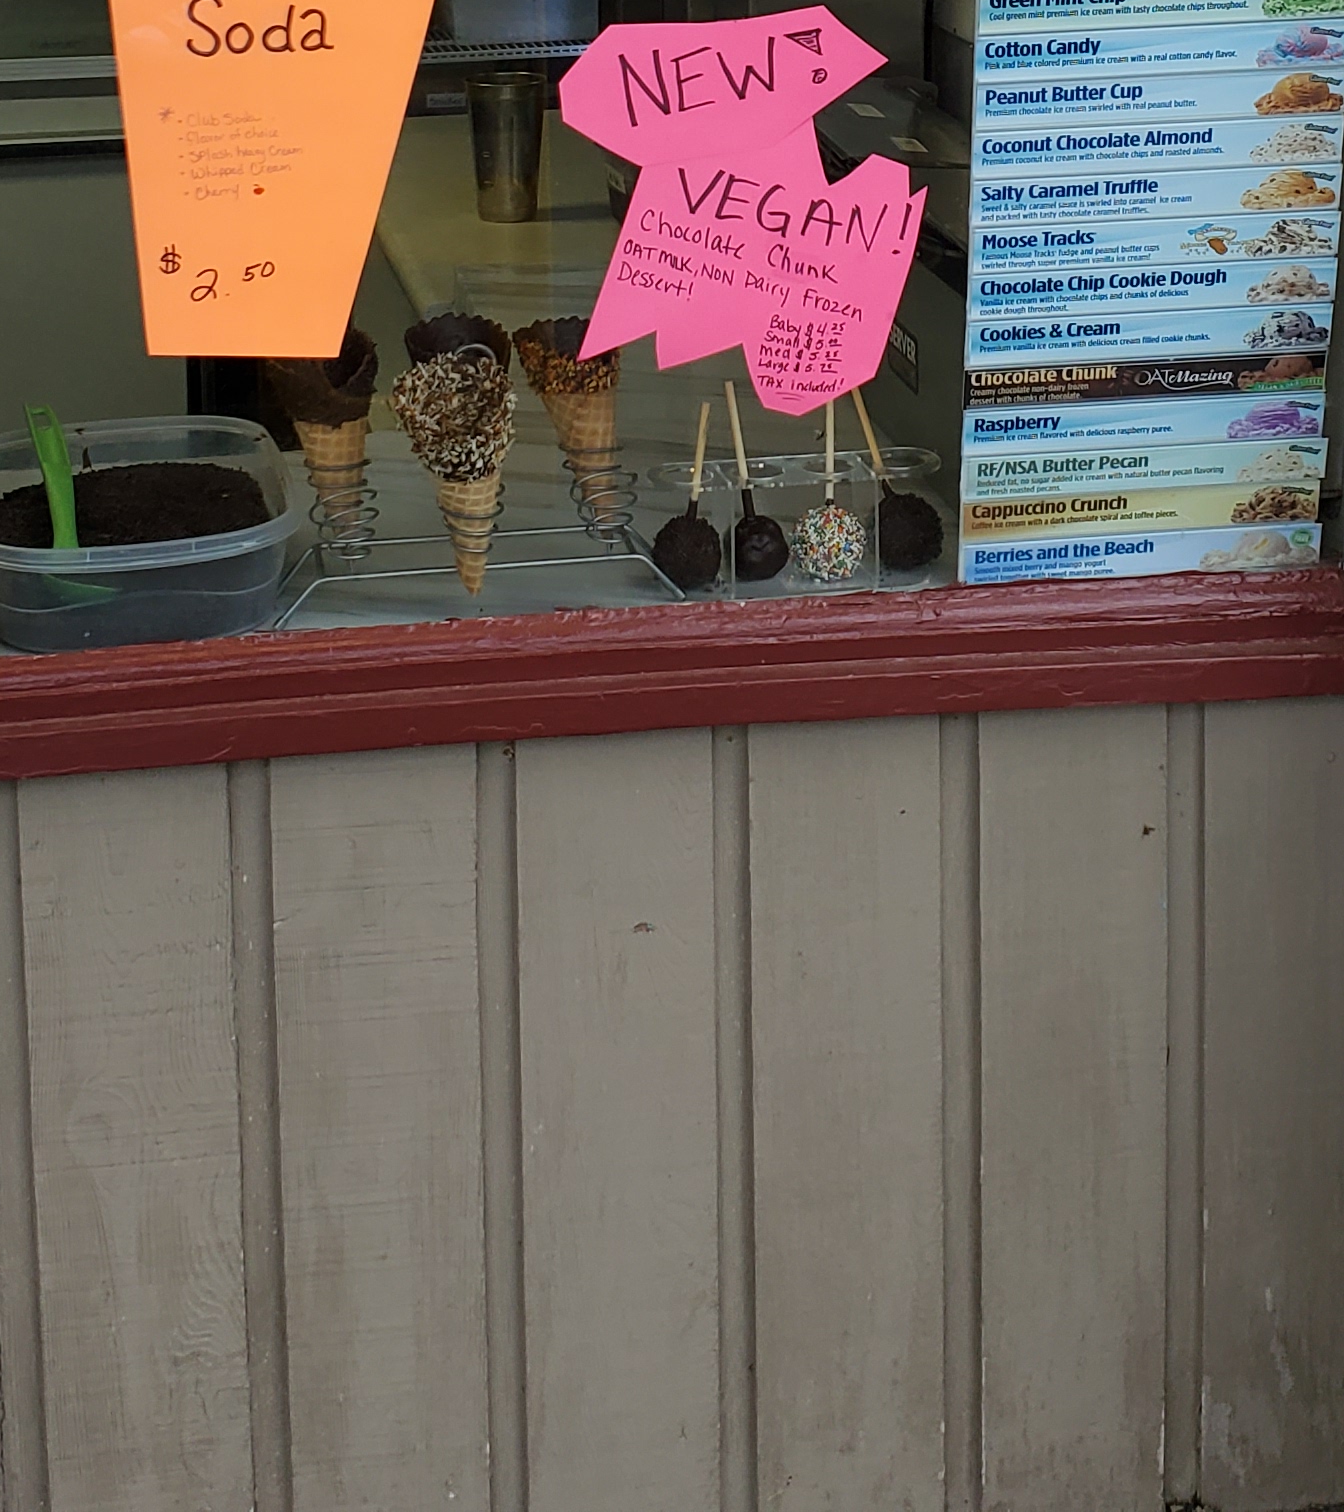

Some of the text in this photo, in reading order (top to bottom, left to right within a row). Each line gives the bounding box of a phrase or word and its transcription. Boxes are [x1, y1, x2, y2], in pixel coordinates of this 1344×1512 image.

[985, 38, 1101, 59] Cotton Candy
[985, 83, 1143, 106] Peanut Butter Cup
[678, 168, 913, 256] VEGAN!
[640, 209, 838, 284] Chocolate Chunk
[982, 230, 1095, 250] Moose Tracks
[980, 322, 1121, 343] Cookies & Cream
[757, 375, 783, 388] TAX
[974, 416, 1060, 433] Raspberry
[977, 455, 1149, 478] RF/NSA Butter Pecan
[972, 496, 1128, 520] Cappuccino Crunch
